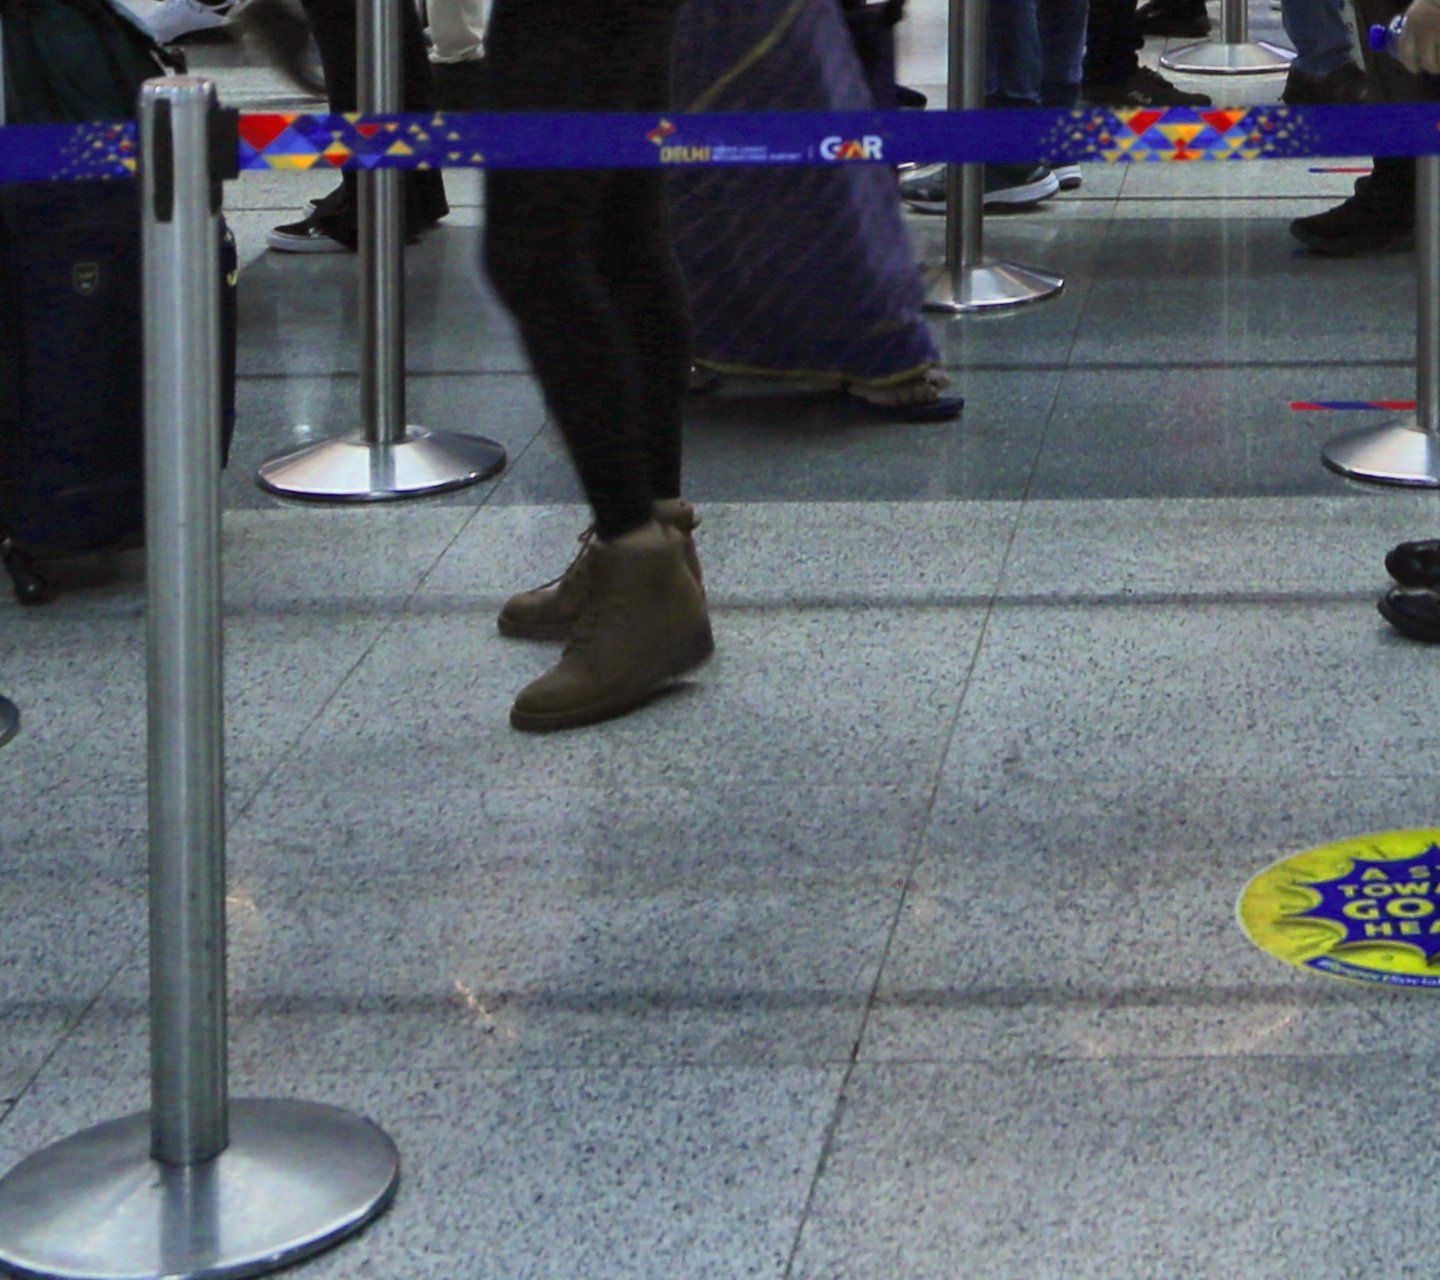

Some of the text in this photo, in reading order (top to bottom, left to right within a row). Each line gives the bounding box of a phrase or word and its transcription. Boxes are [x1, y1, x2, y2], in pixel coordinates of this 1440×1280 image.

[660, 146, 709, 162] DELHI
[820, 135, 882, 160] GMR
[1361, 867, 1388, 880] A
